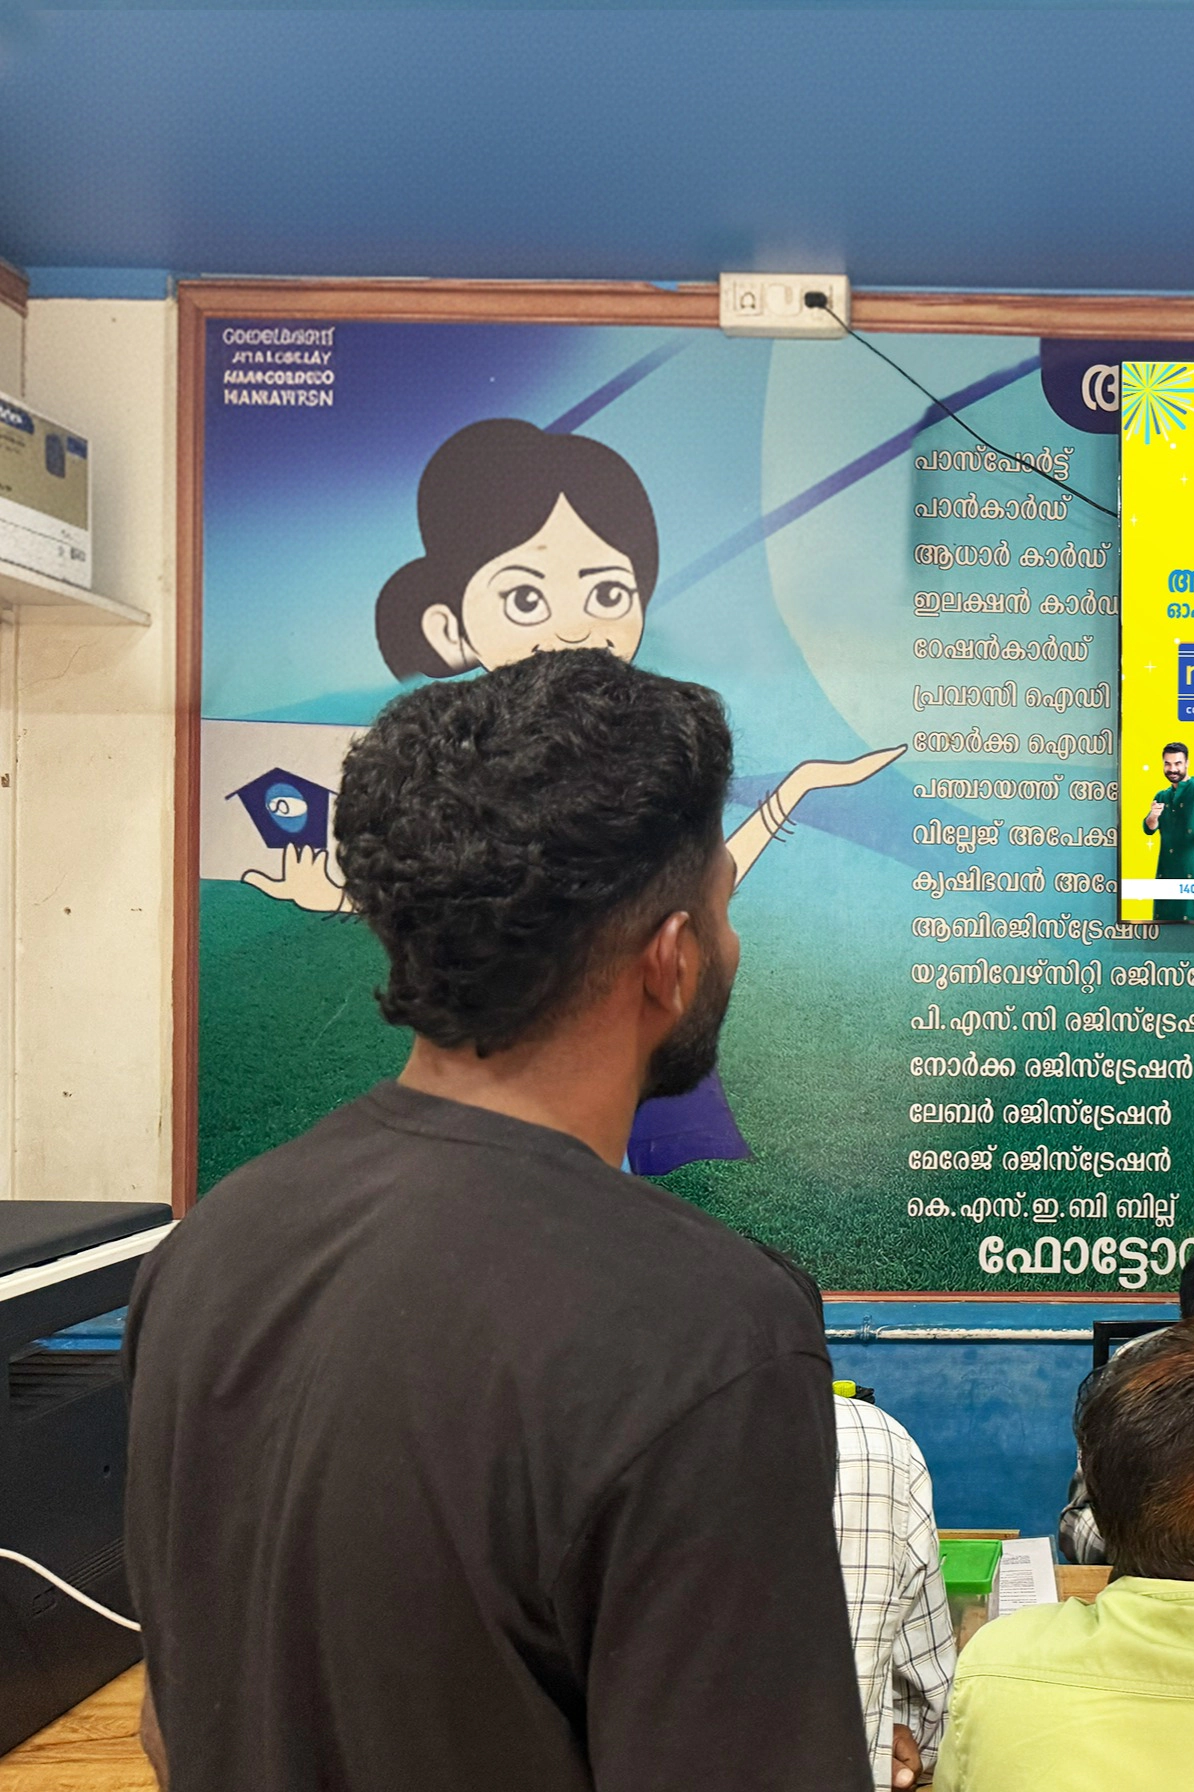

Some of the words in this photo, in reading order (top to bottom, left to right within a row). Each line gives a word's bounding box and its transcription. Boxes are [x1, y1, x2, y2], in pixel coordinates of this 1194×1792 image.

[914, 493, 1072, 520] പാൻകാർഡ്
[914, 541, 1011, 570] ആധാർ
[1019, 542, 1112, 568] കാർഡ്
[914, 588, 1030, 617] ഇലക്ഷൻ
[913, 634, 1093, 660] റേഷൻകാർഡ്
[1026, 682, 1110, 712] ഐഡി
[913, 727, 1019, 754] നോർക്ക
[1028, 729, 1113, 760] ഐഡി
[910, 1051, 1016, 1079] നോർക്ക
[909, 1098, 993, 1124] ലേബർ
[908, 1145, 997, 1170] മേരേജ്
[1117, 1192, 1180, 1228] ബില്ല്
